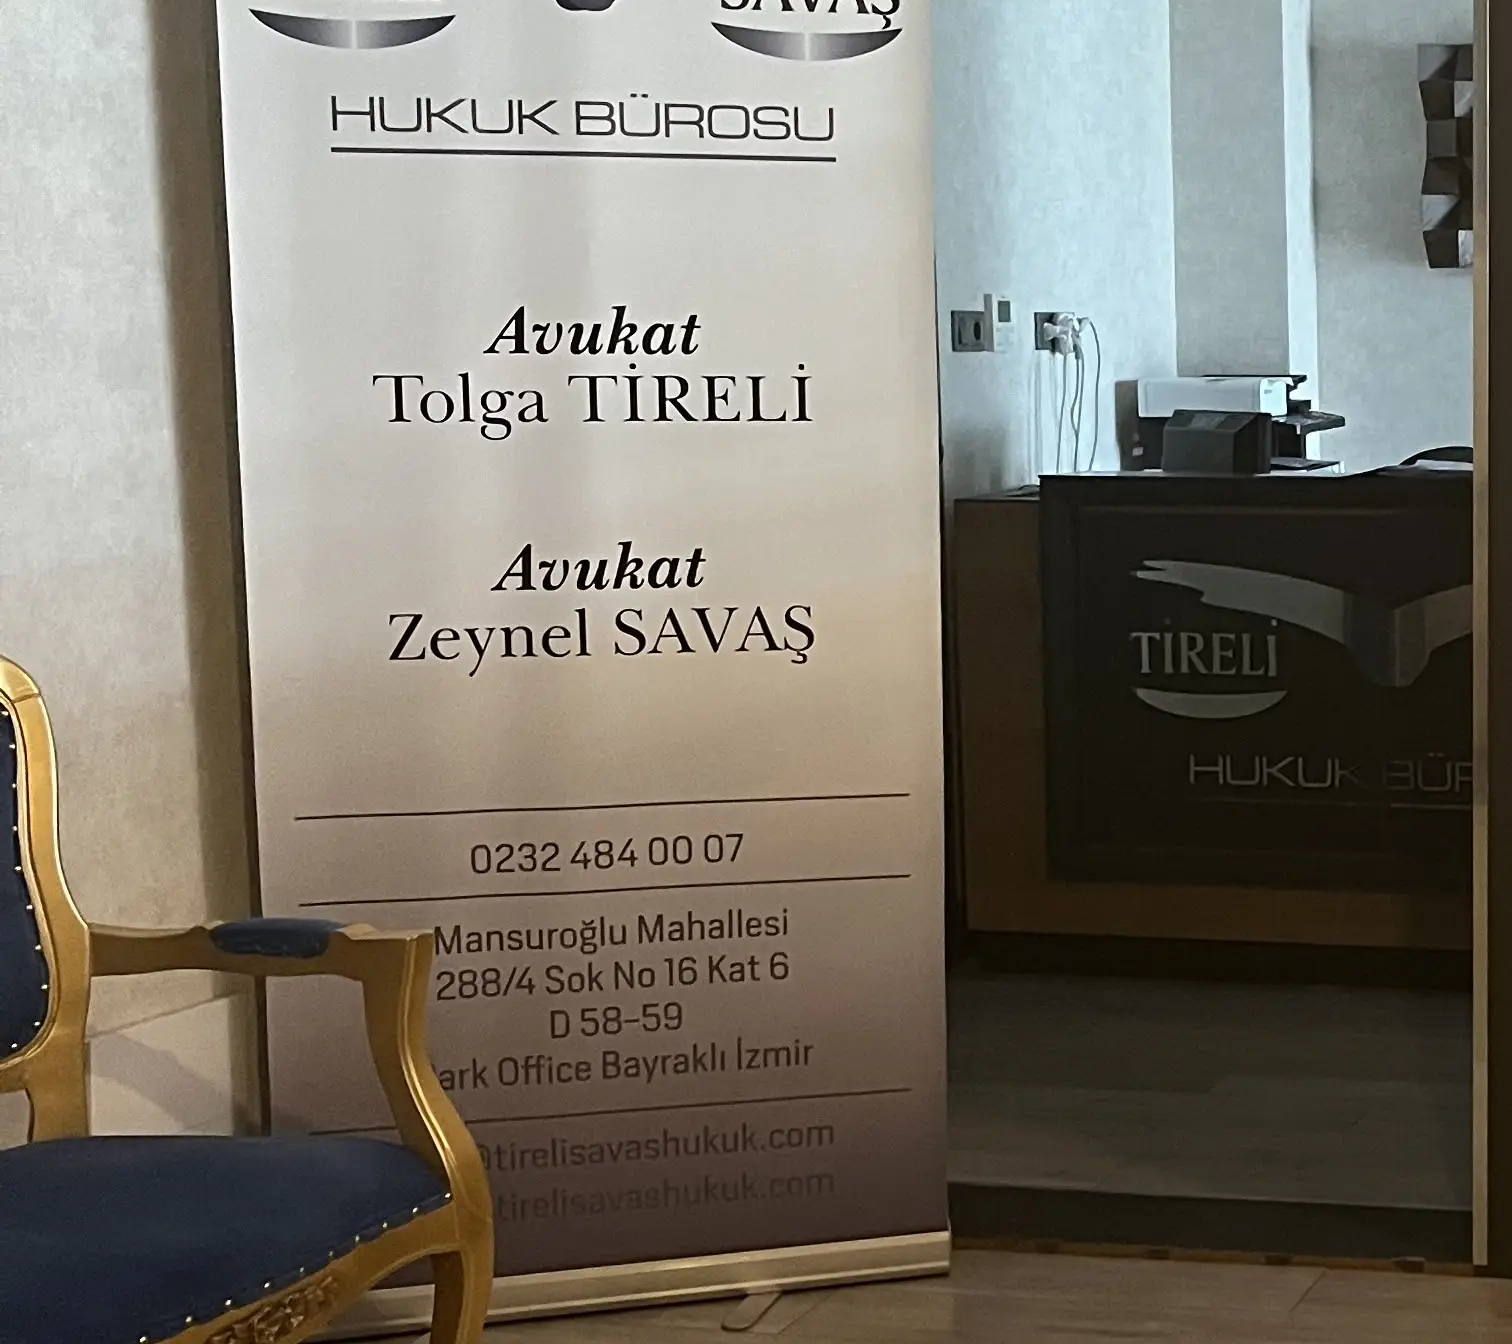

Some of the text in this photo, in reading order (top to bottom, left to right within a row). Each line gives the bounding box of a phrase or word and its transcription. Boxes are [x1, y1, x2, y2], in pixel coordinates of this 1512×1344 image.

[330, 93, 835, 142] HUKUK BÜROSU
[483, 305, 702, 355] Avukat
[372, 363, 813, 440] Tolga TİRELİ
[490, 541, 707, 592] Avukat
[388, 605, 816, 677] Zeynel SAVAŞ
[1129, 617, 1278, 677] TİRELİ
[1188, 756, 1367, 789] HUKUK
[470, 833, 745, 874] 0232 484 00 07
[432, 908, 790, 956] Mansuroğlu Mahallesi
[435, 952, 791, 1002] 288/4 Sok No 16 Kat 6
[550, 1010, 570, 1039] D
[432, 1036, 815, 1092] ark Office Bayraklı İzmir
